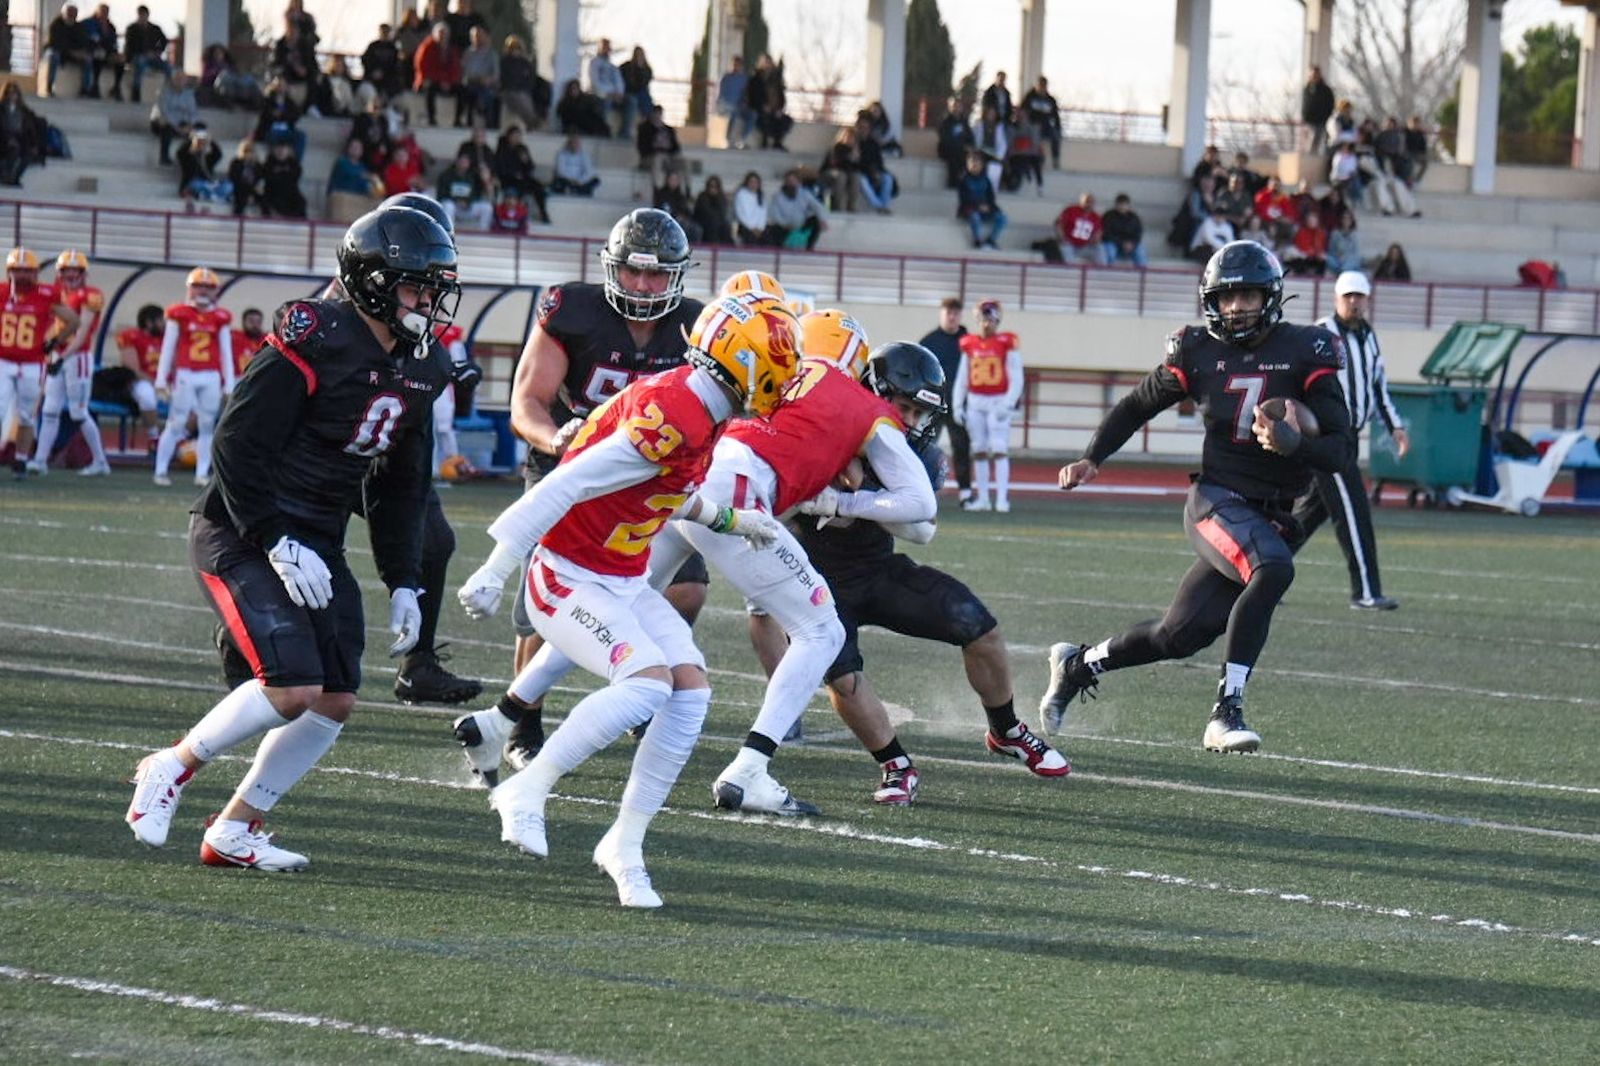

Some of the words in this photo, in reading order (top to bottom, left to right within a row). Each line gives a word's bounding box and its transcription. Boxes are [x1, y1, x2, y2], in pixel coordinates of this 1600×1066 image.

[1, 312, 37, 350] 66
[188, 331, 211, 361] 2
[343, 393, 404, 457] 0
[1227, 375, 1266, 441] 7
[624, 402, 683, 462] 23
[775, 545, 815, 589] HEX.COM
[570, 604, 617, 648] HEX.COM
